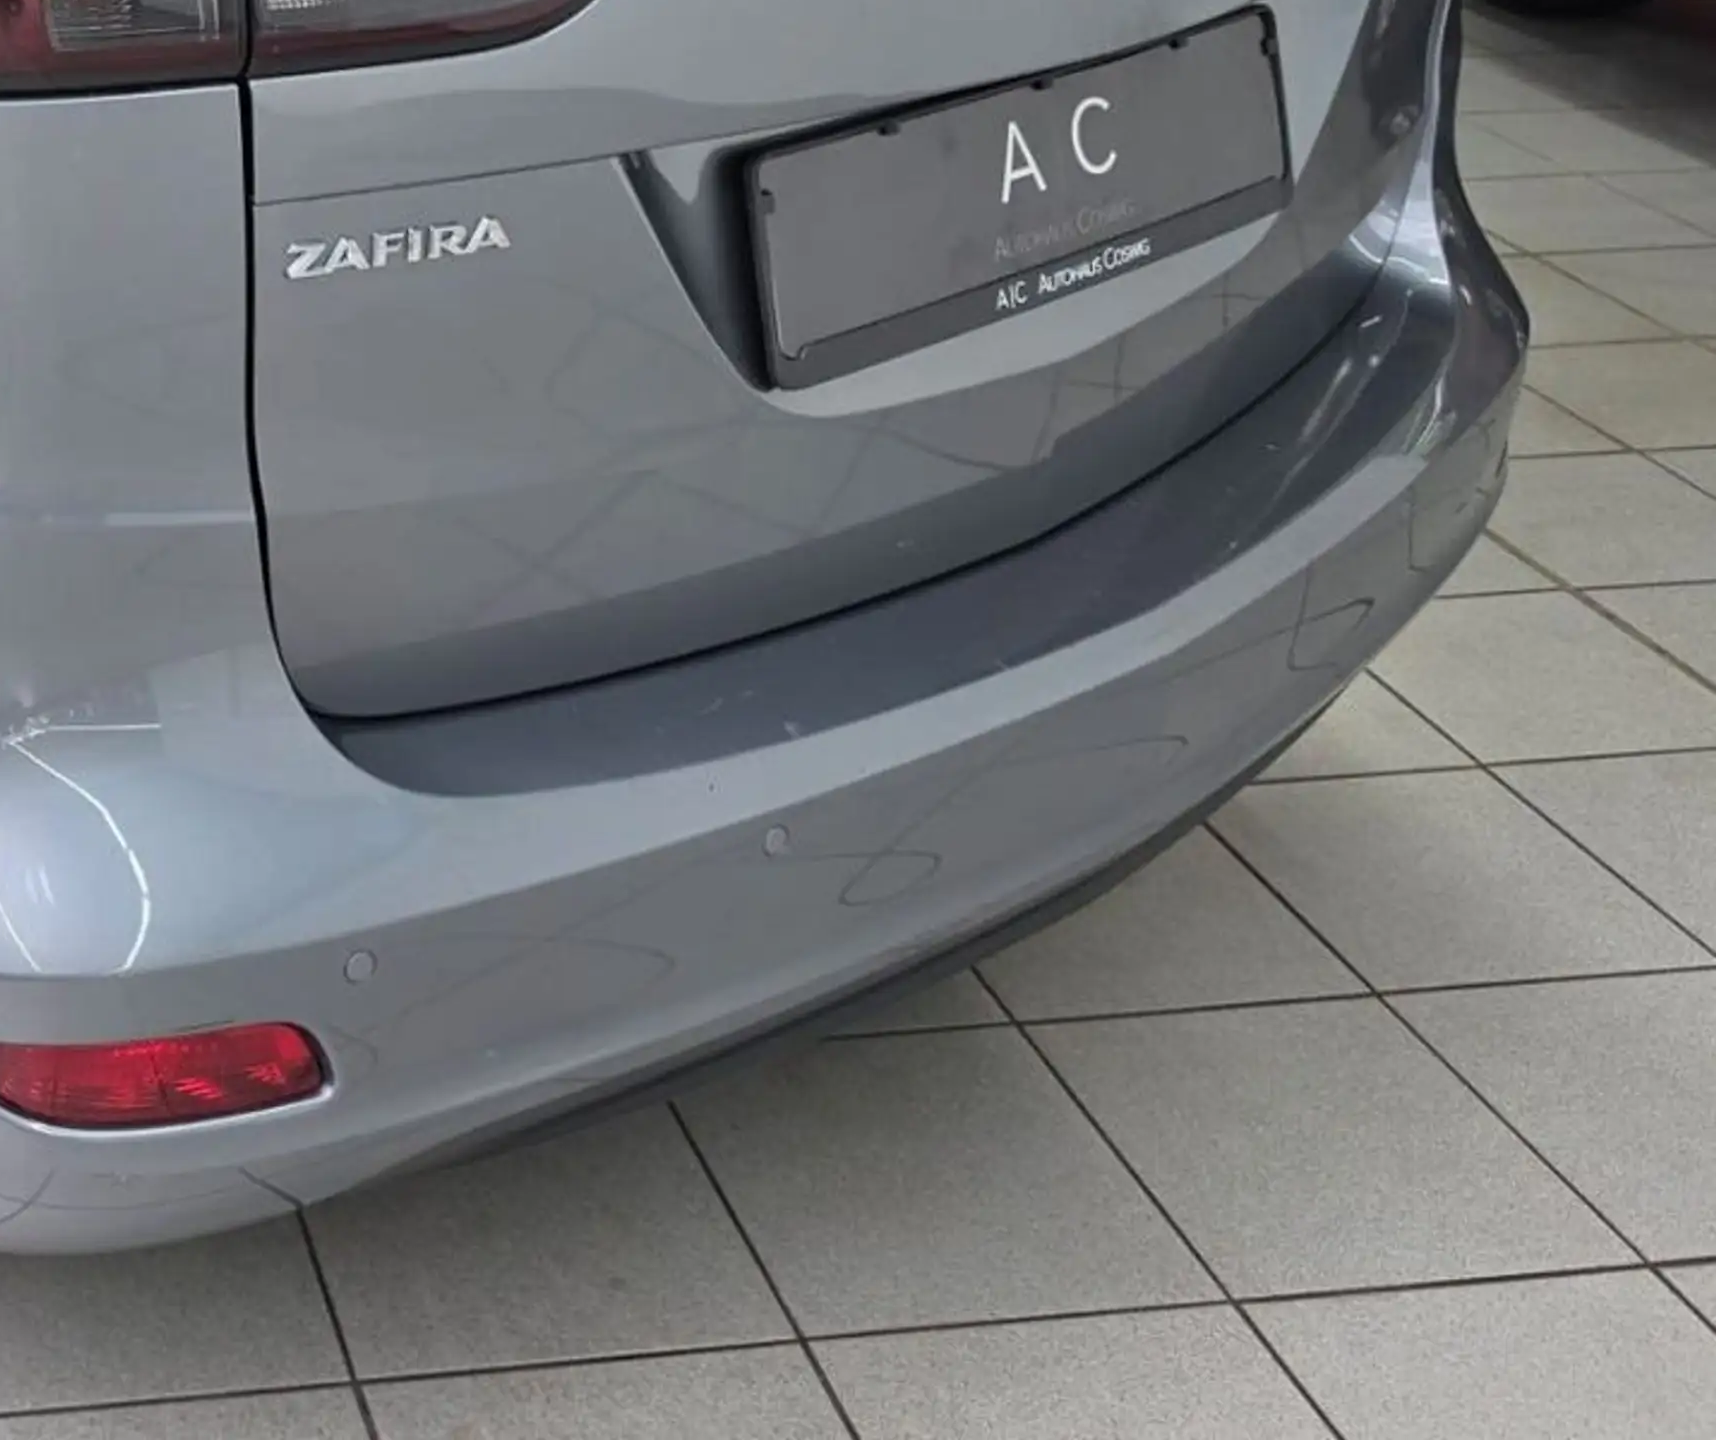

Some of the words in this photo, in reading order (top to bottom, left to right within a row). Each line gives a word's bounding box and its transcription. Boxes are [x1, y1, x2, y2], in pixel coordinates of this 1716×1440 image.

[1001, 121, 1047, 204] A
[1071, 97, 1118, 174] C
[285, 215, 512, 279] ZAFIRA
